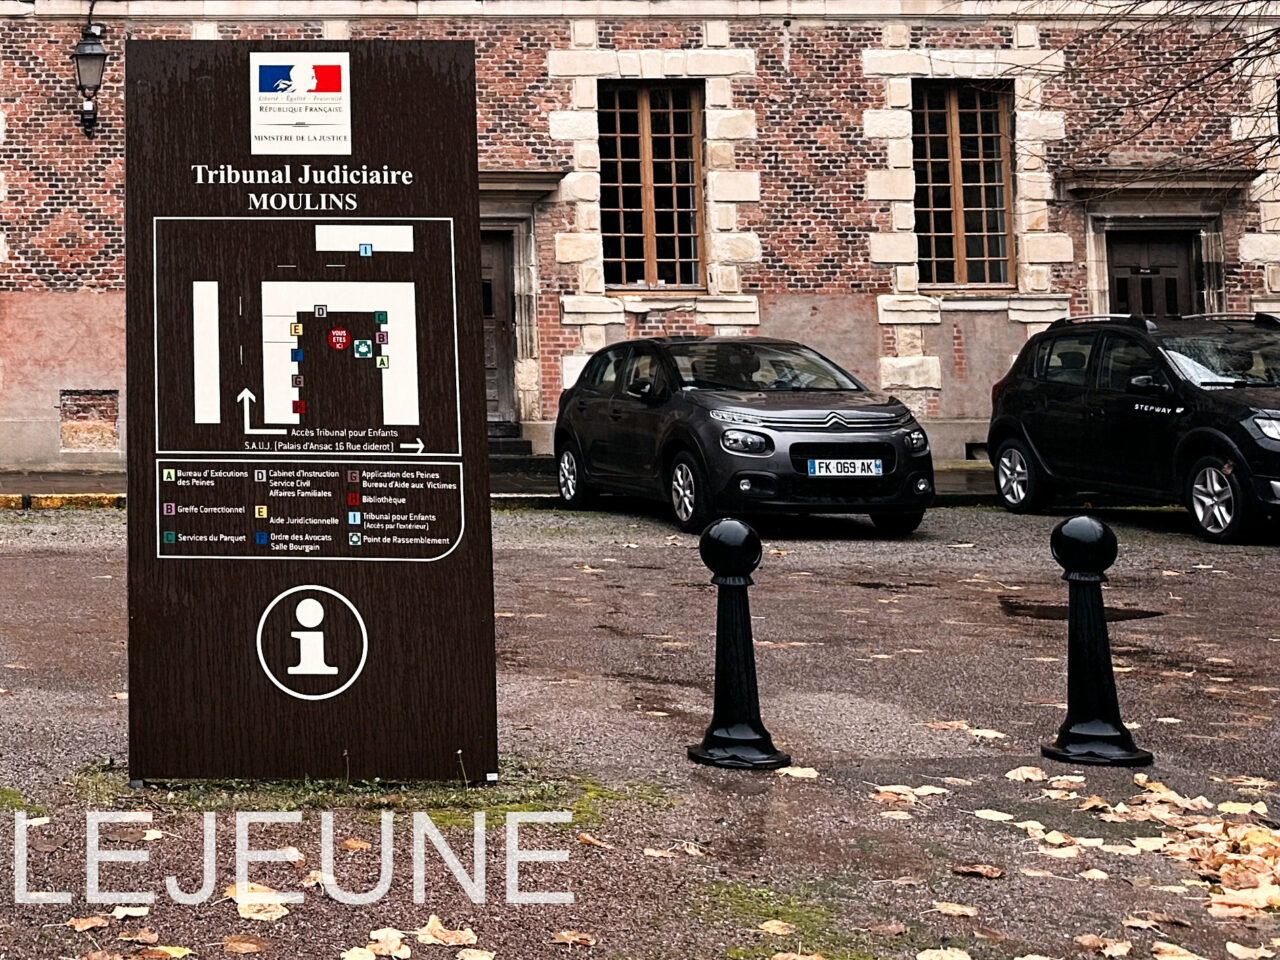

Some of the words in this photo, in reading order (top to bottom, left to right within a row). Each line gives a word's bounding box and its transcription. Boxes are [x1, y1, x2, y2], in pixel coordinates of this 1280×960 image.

[191, 164, 292, 185] Tribunal
[298, 164, 414, 186] Judiciaire
[248, 193, 358, 211] MOULINS
[1134, 403, 1172, 414] STEPWAY
[291, 428, 315, 437] Accès
[316, 428, 347, 437] Tribunal
[348, 429, 366, 439] pour
[367, 428, 399, 437] Enfants
[302, 442, 333, 450] d'Ansac
[335, 442, 345, 451] 16
[346, 442, 361, 451] Rue
[176, 469, 202, 477] Bureau
[210, 469, 249, 477] Exécutions
[269, 469, 295, 477] Cabinet
[296, 469, 340, 478] d'Instruction
[362, 470, 400, 479] Application
[401, 471, 415, 479] des
[416, 471, 440, 479] Peines
[192, 478, 215, 486] Peines
[388, 481, 410, 489] d'Aide
[426, 481, 457, 490] Victimes
[269, 489, 296, 497] Affaires
[362, 495, 406, 505] Bibliothèque
[177, 505, 199, 513] Greffe
[200, 505, 246, 514] Correctionnel
[286, 517, 340, 525] Juridictionnelle
[363, 512, 391, 520] Tribunal
[391, 514, 408, 522] pour
[409, 513, 437, 521] Enfants
[219, 533, 246, 543] Parquet
[290, 533, 303, 541] des
[363, 535, 380, 543] Point
[392, 536, 450, 544] Rassemblement
[289, 543, 320, 552] Bourgain
